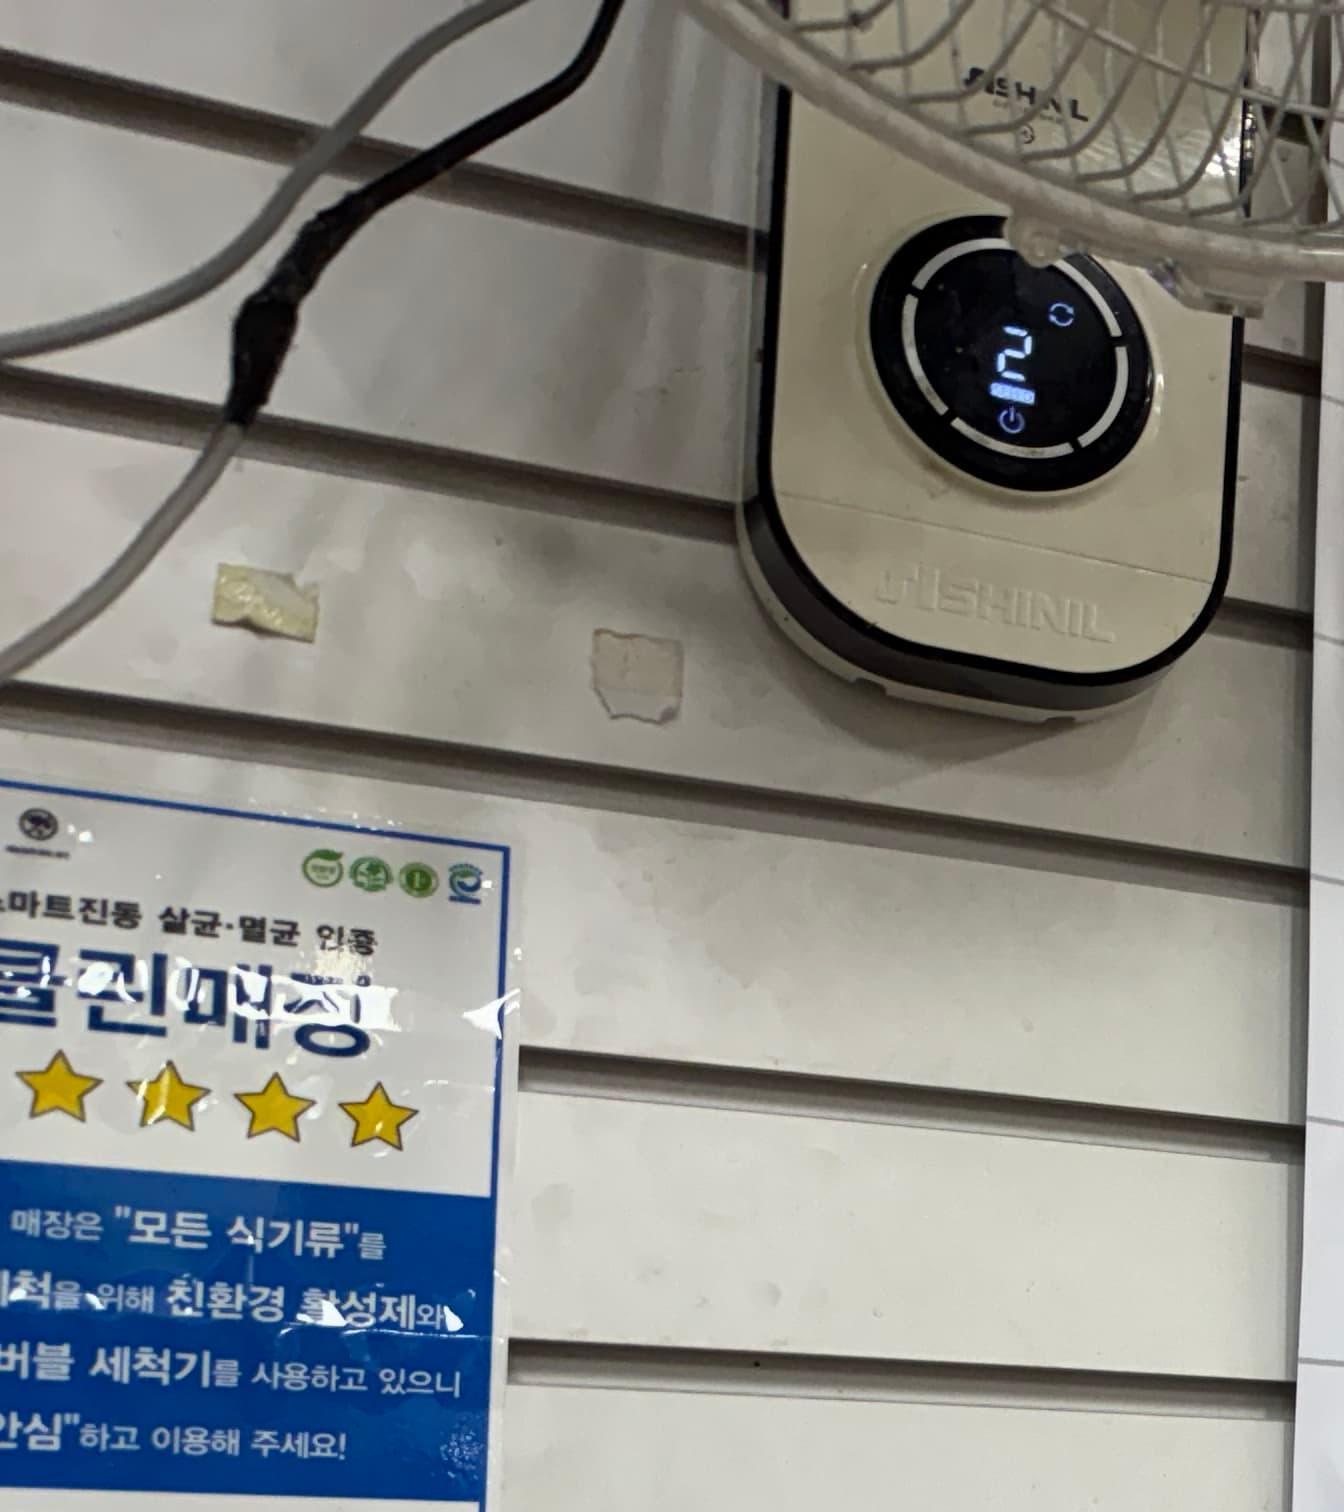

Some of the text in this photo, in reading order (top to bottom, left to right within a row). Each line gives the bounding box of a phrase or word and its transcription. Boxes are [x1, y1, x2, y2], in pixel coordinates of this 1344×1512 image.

[10, 1206, 387, 1262] 매장은 "모든 식기류"를
[97, 1282, 155, 1314] 위해
[166, 1276, 286, 1323] 친환경
[89, 1346, 242, 1390] 세척기를
[251, 1363, 369, 1395] 사용하고
[378, 1369, 461, 1400] 있으니
[151, 1426, 241, 1457] 이용해
[250, 1430, 347, 1462] 주세요!
